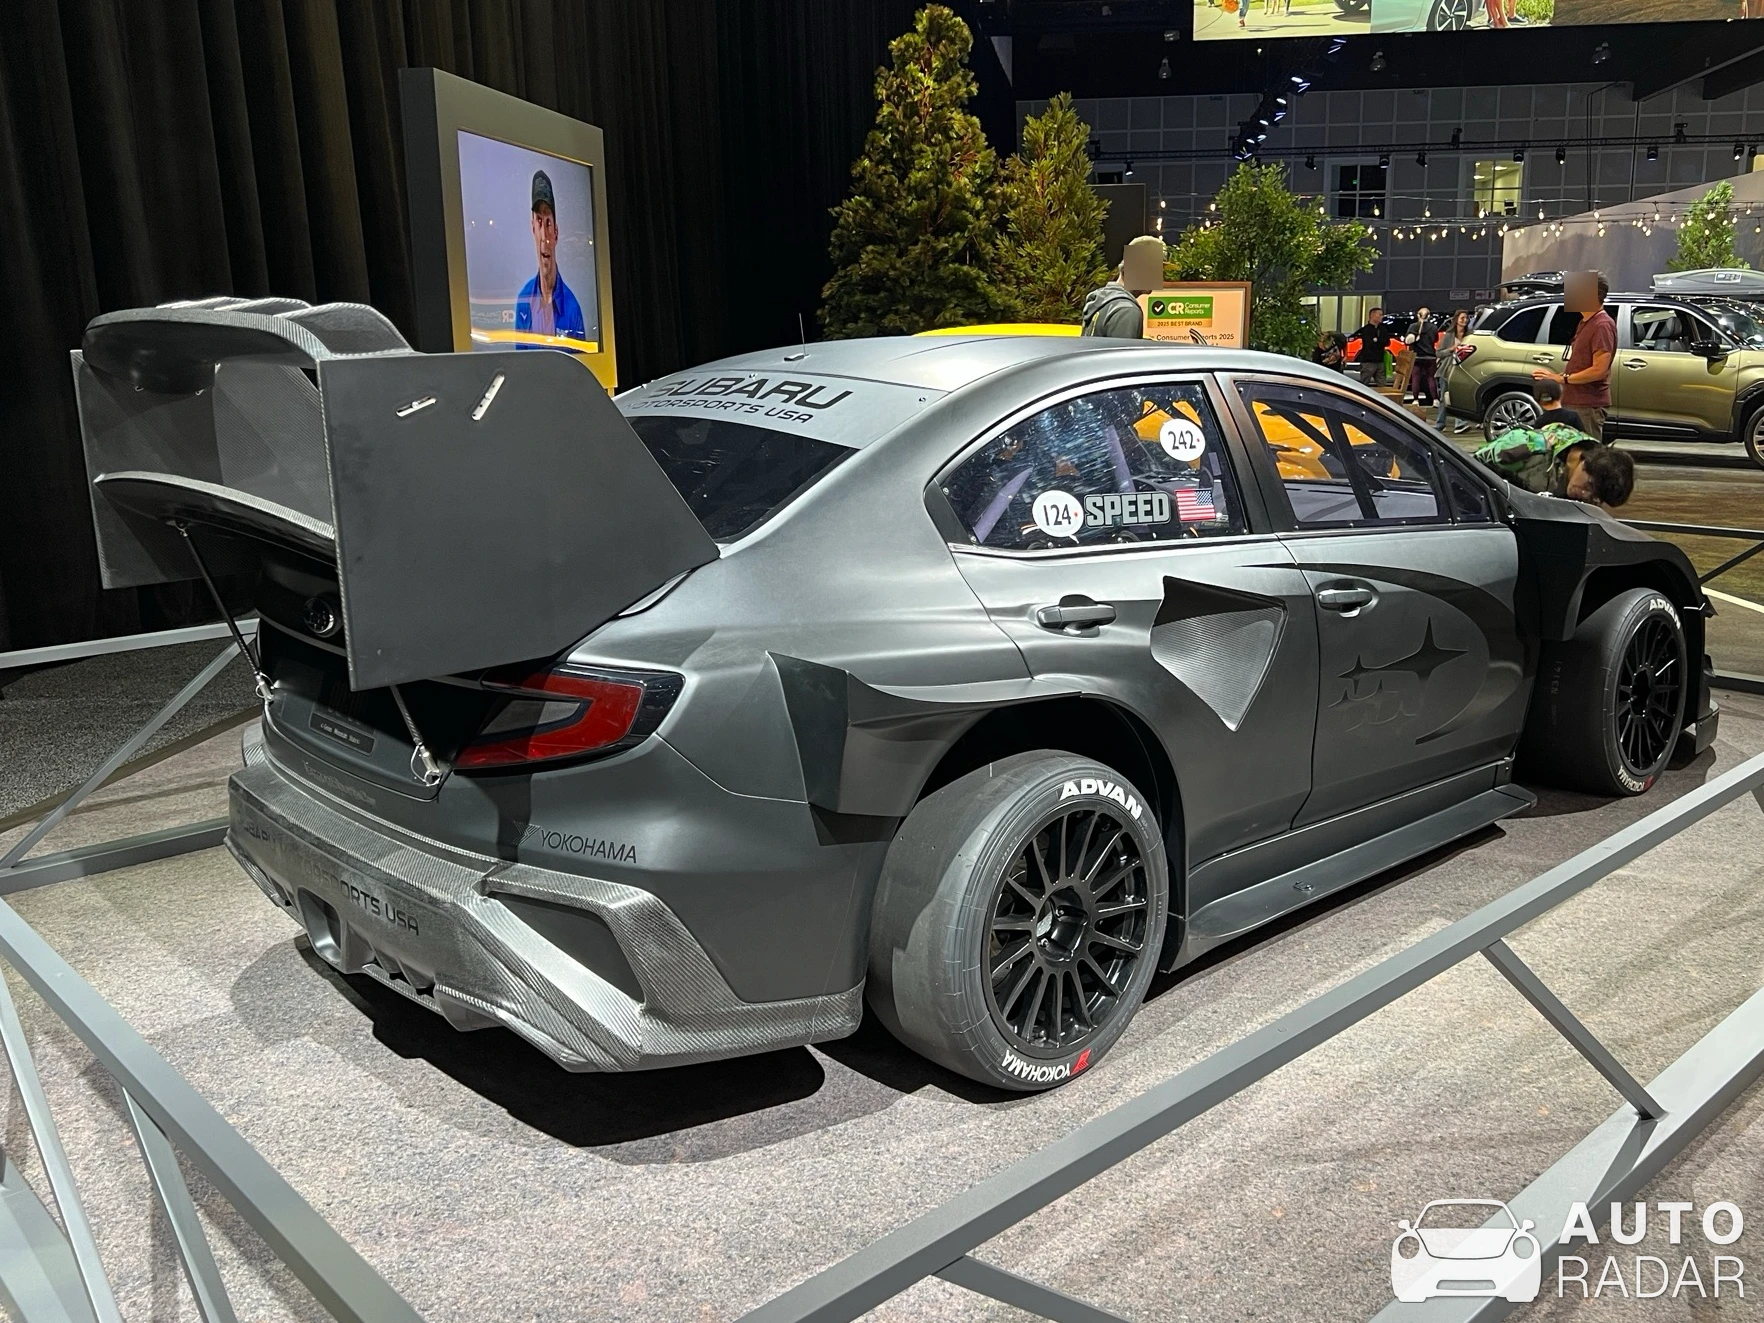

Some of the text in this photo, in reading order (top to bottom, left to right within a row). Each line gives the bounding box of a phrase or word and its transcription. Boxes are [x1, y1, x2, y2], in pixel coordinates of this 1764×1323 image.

[1167, 302, 1185, 315] CR
[647, 377, 853, 410] SUBARU
[764, 406, 814, 424] USA
[1168, 430, 1198, 451] 242
[1043, 503, 1072, 527] 124
[1085, 492, 1170, 528] SPEED
[1649, 598, 1681, 630] ADVAN
[1059, 778, 1143, 820] ADVAN
[540, 829, 637, 864] YOKOHAMA
[384, 902, 420, 937] USA
[1002, 1050, 1071, 1082] YOKOHAMA
